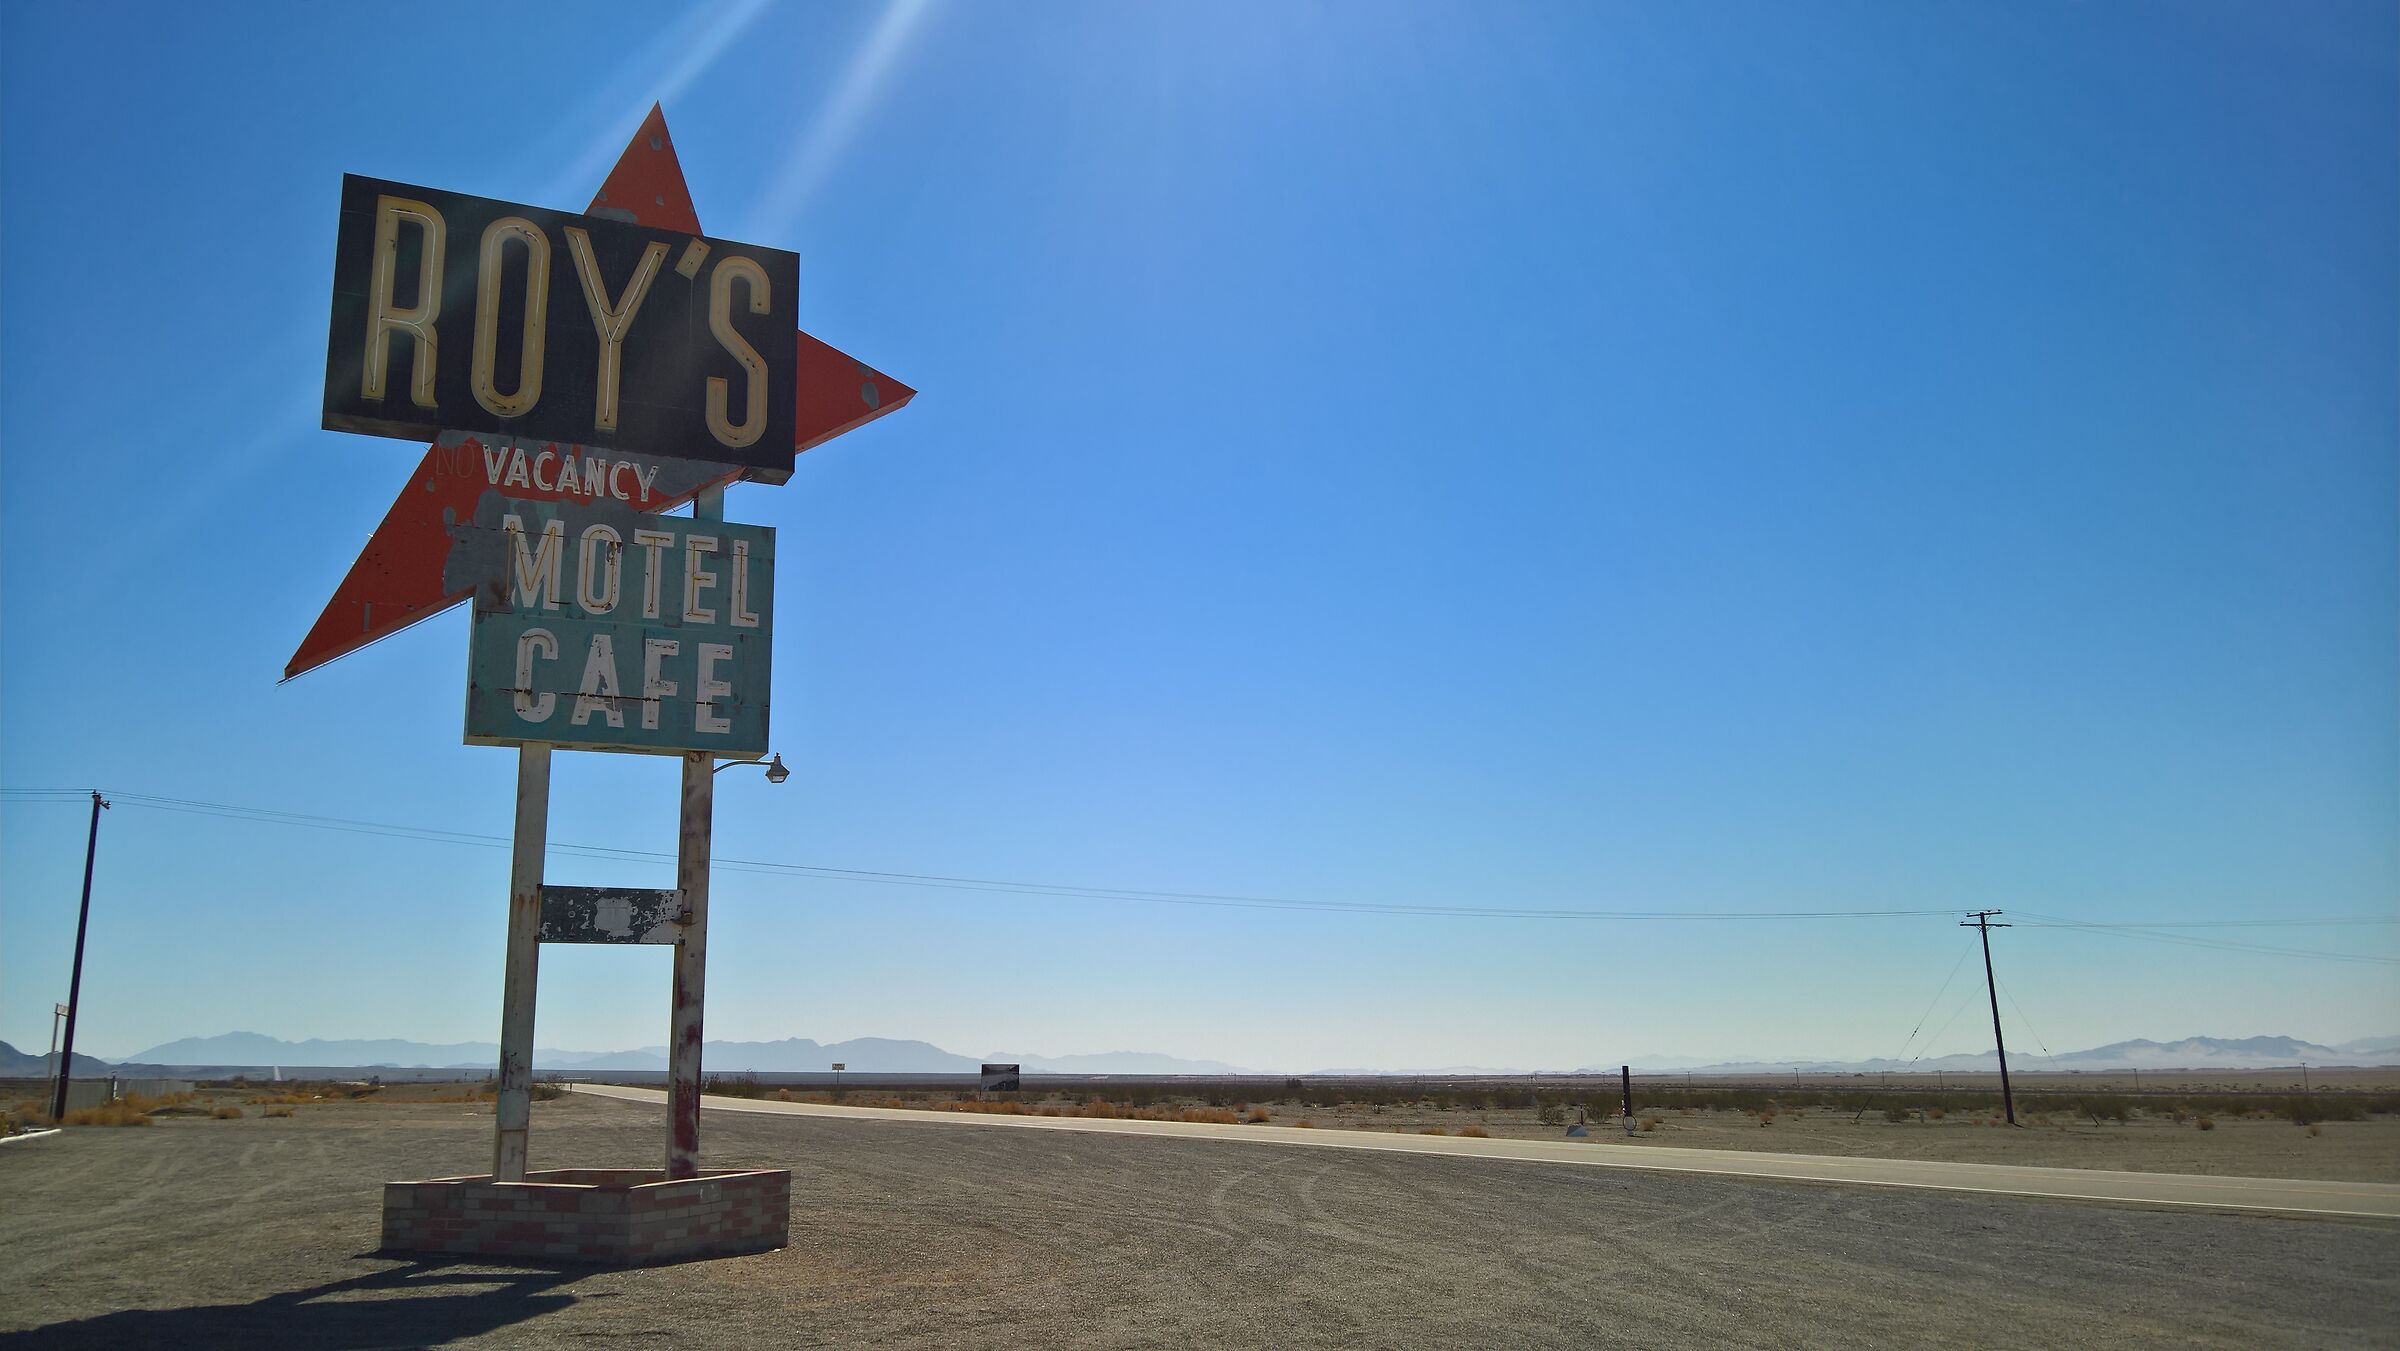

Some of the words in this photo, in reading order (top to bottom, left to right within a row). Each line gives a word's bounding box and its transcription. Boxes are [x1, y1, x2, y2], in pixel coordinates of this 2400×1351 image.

[361, 193, 771, 448] ROY'S
[435, 443, 476, 479] NO
[482, 444, 659, 502] VACANCY
[503, 514, 760, 628] MOTEL
[513, 628, 735, 734] CAFE
